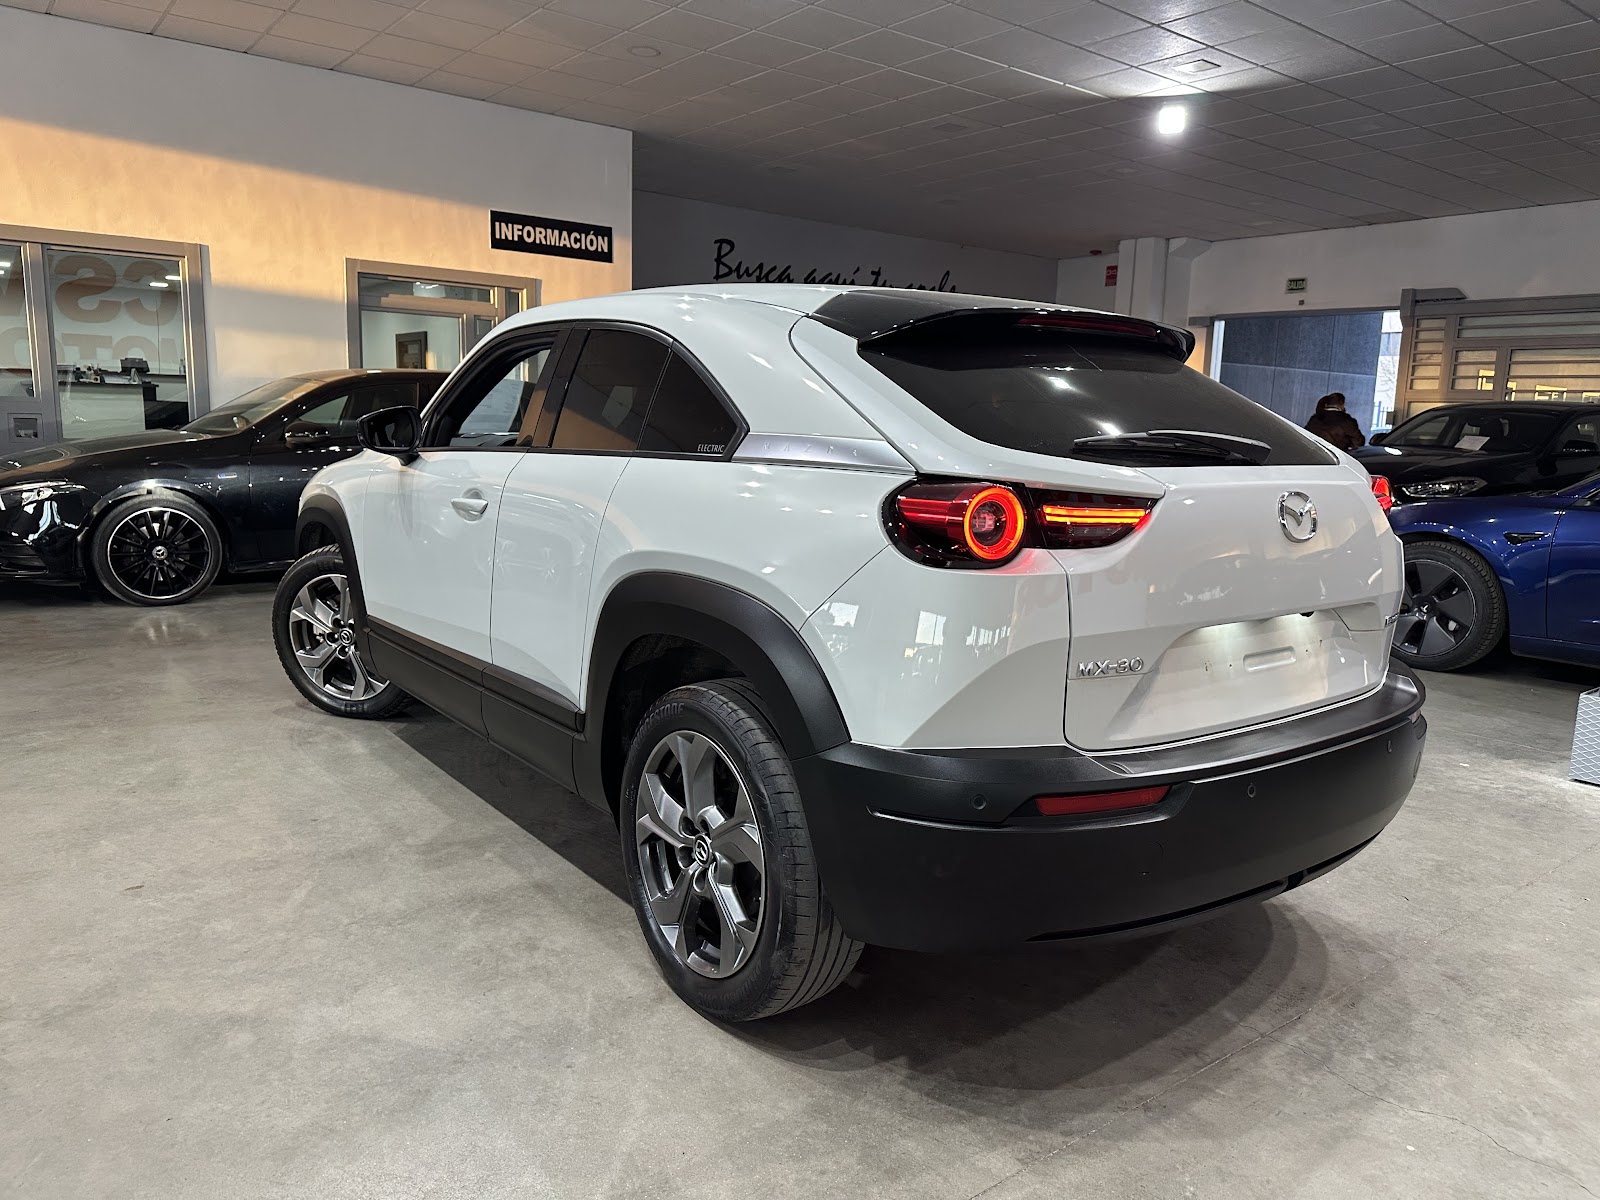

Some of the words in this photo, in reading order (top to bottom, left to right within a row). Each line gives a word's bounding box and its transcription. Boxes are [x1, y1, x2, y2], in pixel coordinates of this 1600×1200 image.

[495, 221, 608, 253] INFORMACIÓN
[713, 238, 794, 283] Busca
[697, 443, 725, 453] ELECTRIC
[1077, 656, 1144, 677] MX-30
